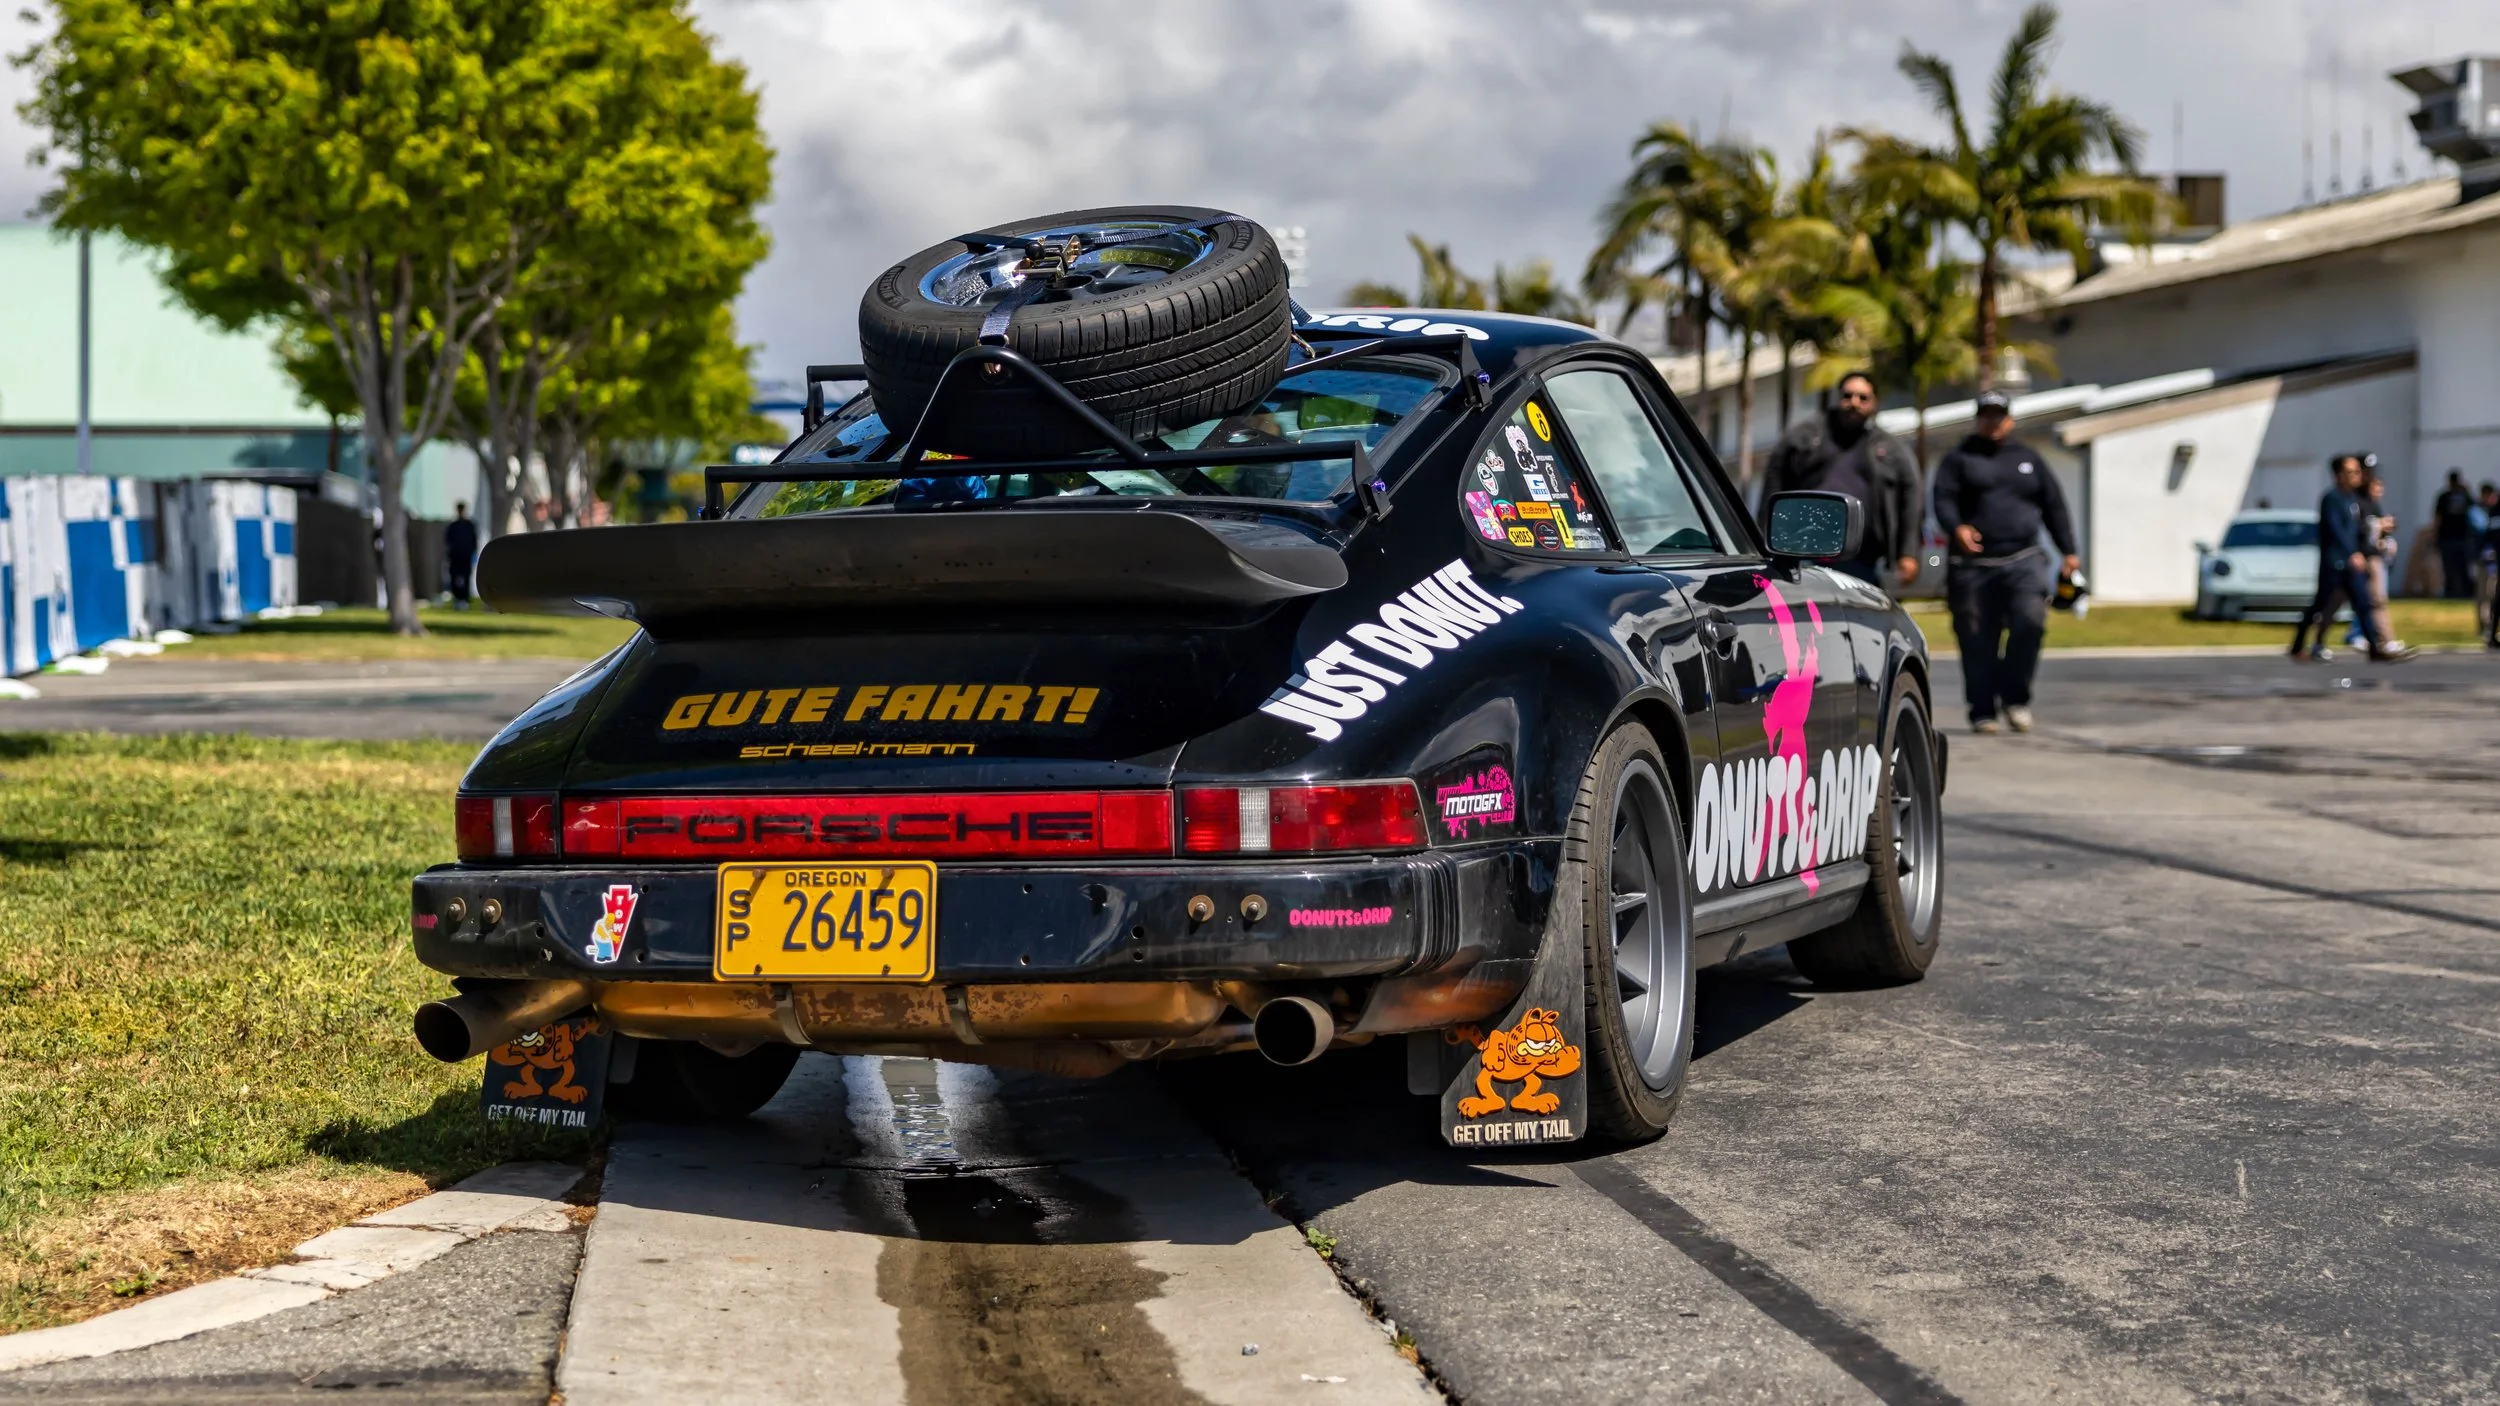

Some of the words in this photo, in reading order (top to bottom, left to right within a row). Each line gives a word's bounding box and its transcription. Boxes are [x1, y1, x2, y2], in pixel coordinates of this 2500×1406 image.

[1153, 280, 1173, 290] ALL
[1179, 265, 1212, 282] SPORT
[1091, 288, 1146, 305] SEASON
[1257, 640, 1408, 742] JUST
[662, 686, 841, 730] GUTE
[843, 684, 1100, 724] FAHRT!
[739, 741, 977, 759] scheel-mann
[1445, 792, 1503, 816] MOTOGFX
[625, 812, 1093, 844] PORSCHE
[1688, 743, 1883, 893] ONUTS&DRIP
[785, 871, 867, 887] OREGON
[782, 888, 924, 951] 26459
[1289, 906, 1393, 927] DONUTS&DRIP
[488, 1103, 514, 1121] GET
[514, 1106, 538, 1123] OFF
[538, 1108, 560, 1126] MY
[561, 1109, 588, 1128] TAIL
[1453, 1123, 1482, 1143] GET
[1484, 1122, 1512, 1142] OFF
[1514, 1121, 1539, 1140] MY
[1539, 1119, 1574, 1139] TAIL
